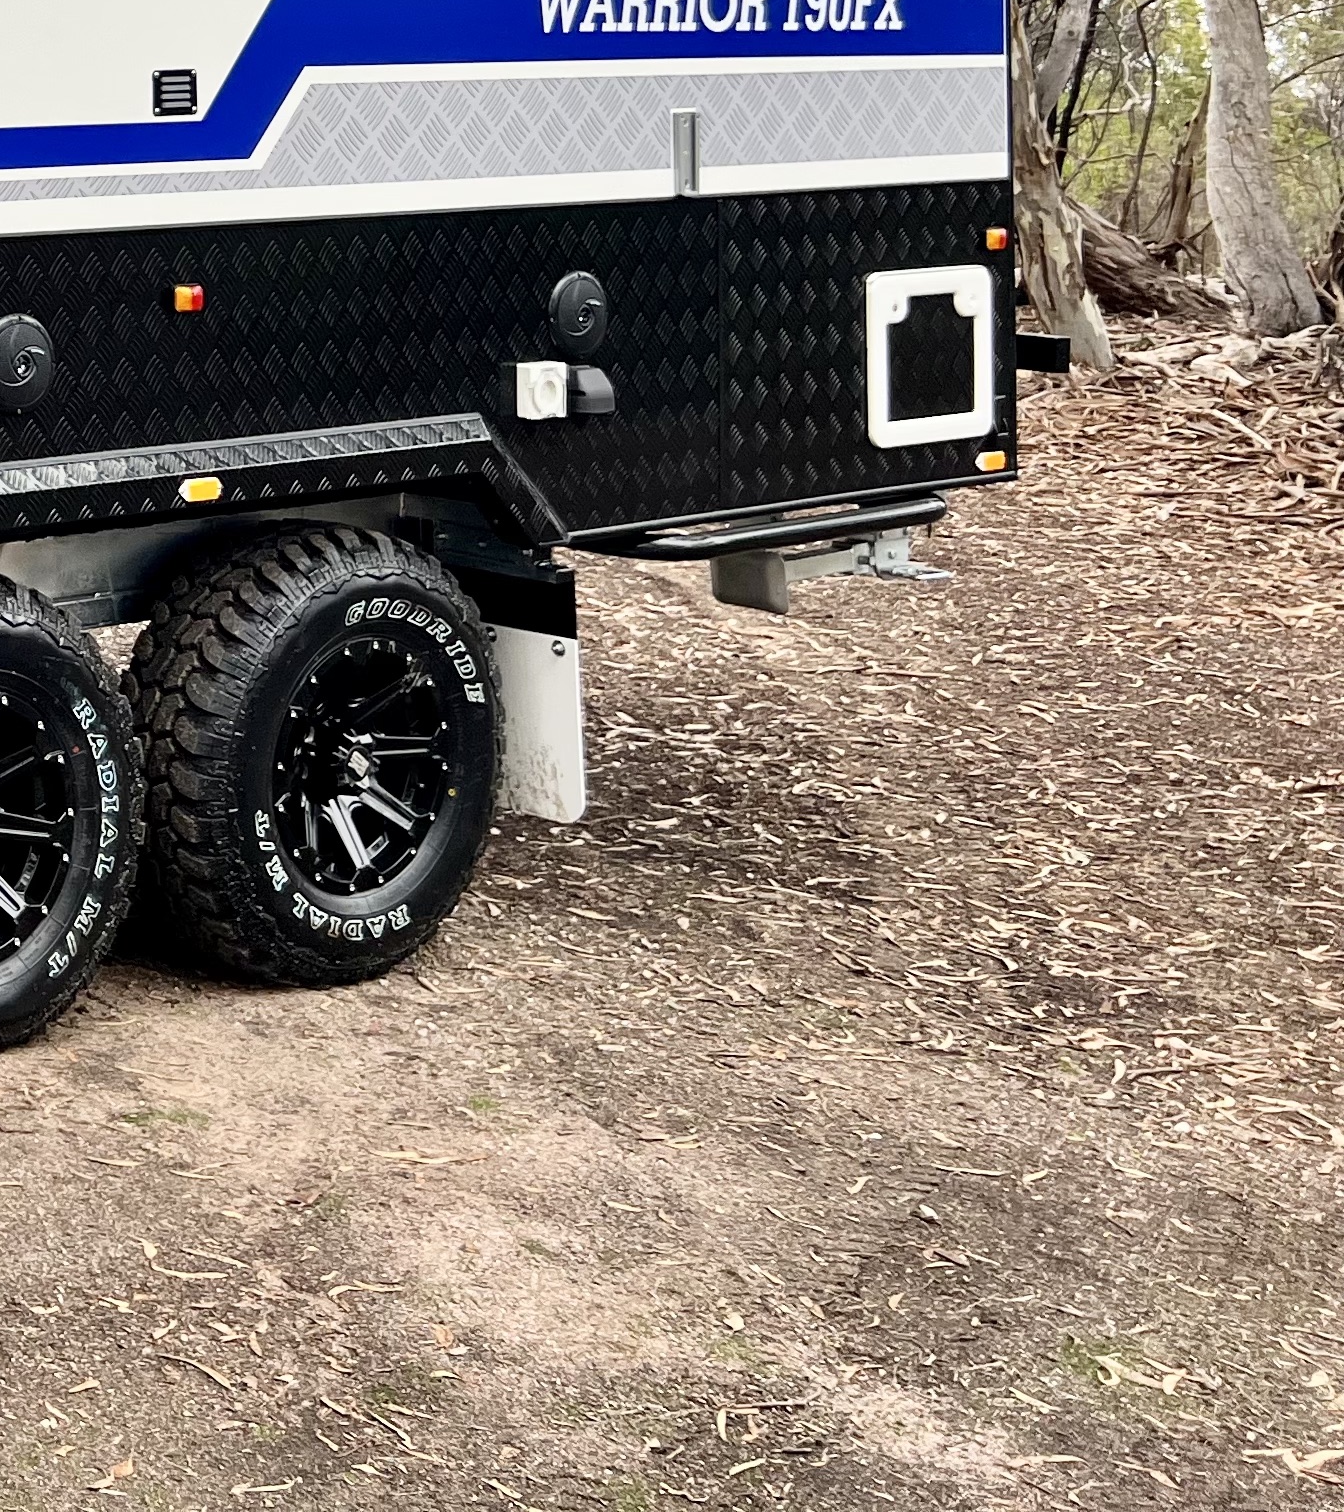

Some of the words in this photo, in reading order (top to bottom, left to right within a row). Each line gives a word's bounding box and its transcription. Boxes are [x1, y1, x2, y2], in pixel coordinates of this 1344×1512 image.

[344, 597, 486, 704] GOODRIDE
[73, 697, 120, 879] RADIAL
[48, 892, 101, 978] M/T
[292, 892, 411, 941] RADIAL
